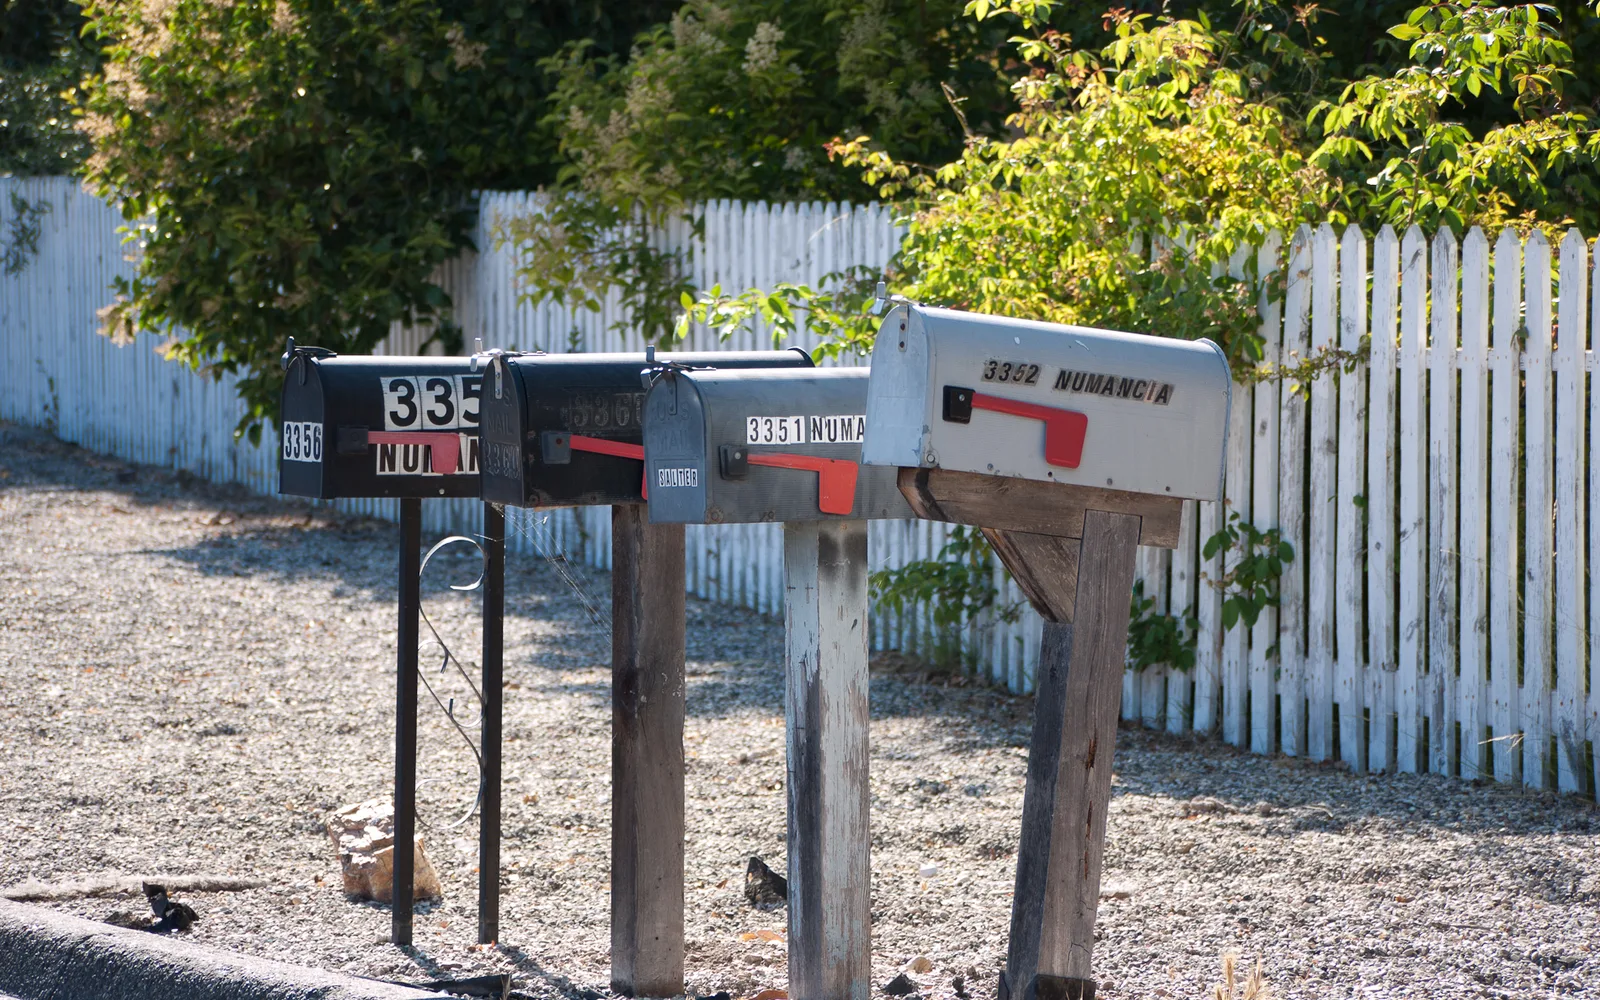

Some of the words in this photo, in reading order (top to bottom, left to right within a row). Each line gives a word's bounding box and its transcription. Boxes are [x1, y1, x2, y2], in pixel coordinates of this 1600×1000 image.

[984, 360, 1040, 384] 3352
[1054, 370, 1170, 404] NUMANCIA
[285, 424, 322, 461] 3356
[749, 415, 803, 444] 3351
[811, 415, 865, 443] NUMA
[659, 469, 697, 487] SALTER
